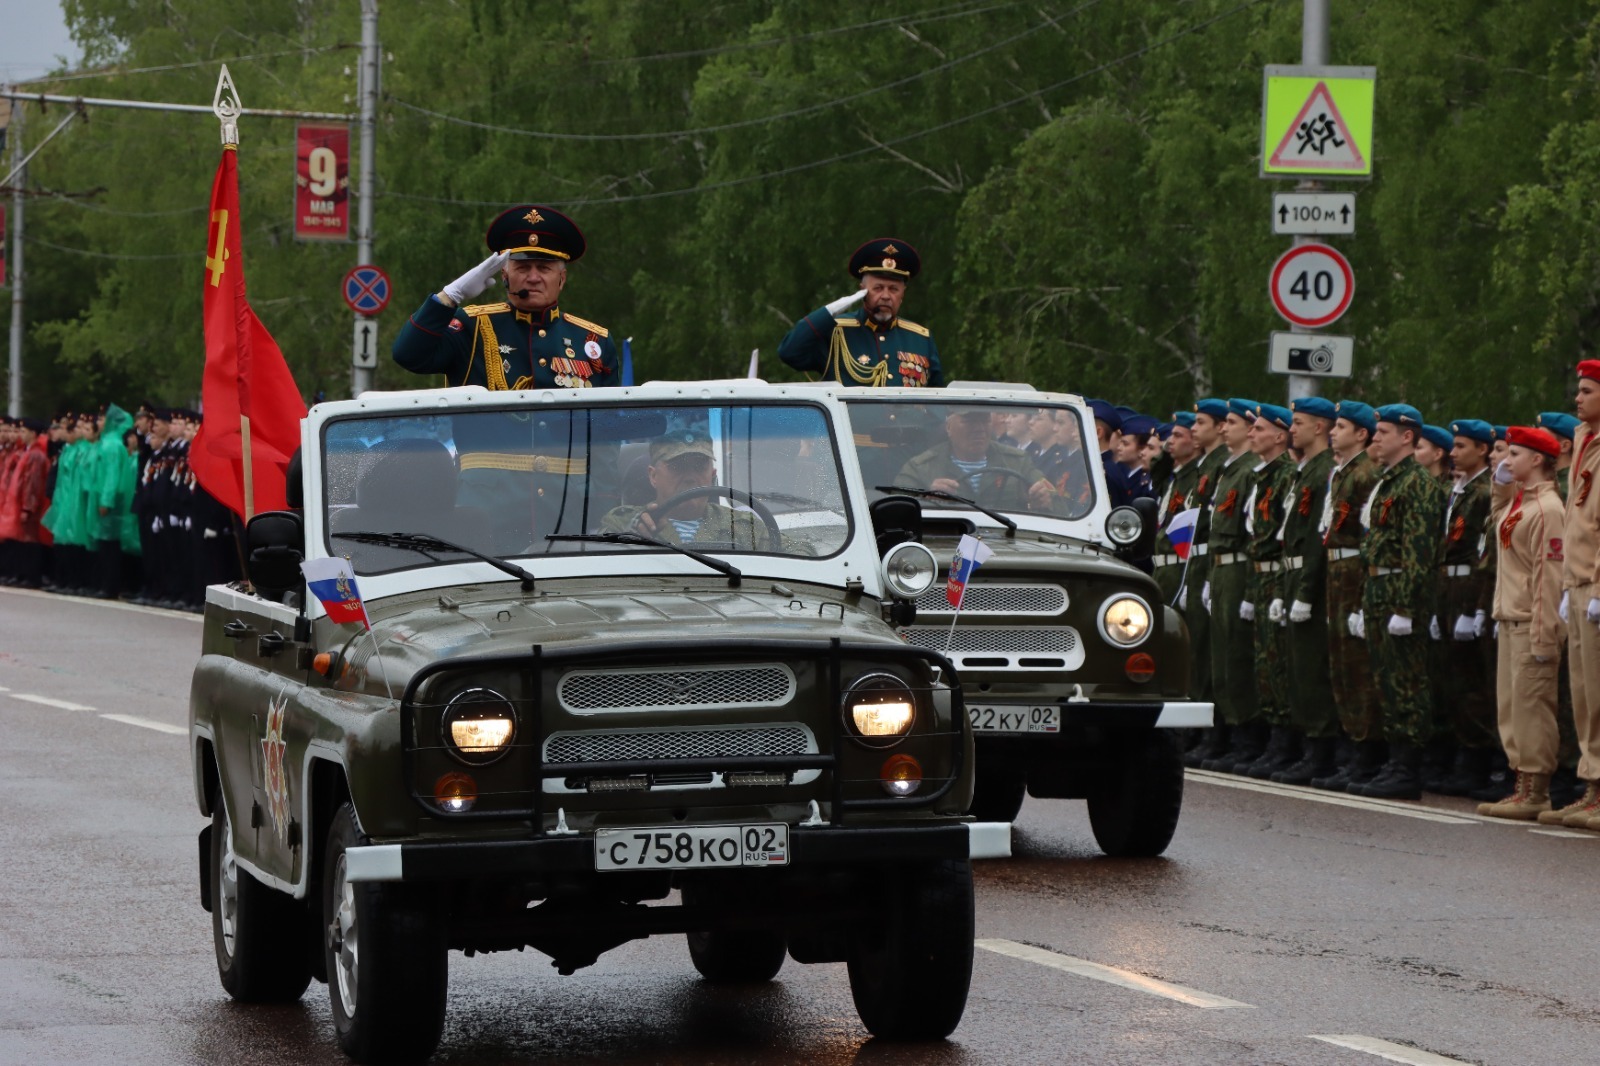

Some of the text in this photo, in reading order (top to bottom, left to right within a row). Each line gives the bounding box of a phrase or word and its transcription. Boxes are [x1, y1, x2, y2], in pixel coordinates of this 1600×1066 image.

[309, 147, 336, 197] 9
[310, 200, 335, 215] МАЯ
[1290, 270, 1334, 301] 40
[1031, 707, 1053, 724] 02
[745, 828, 776, 852] 02
[745, 852, 768, 861] RUS
